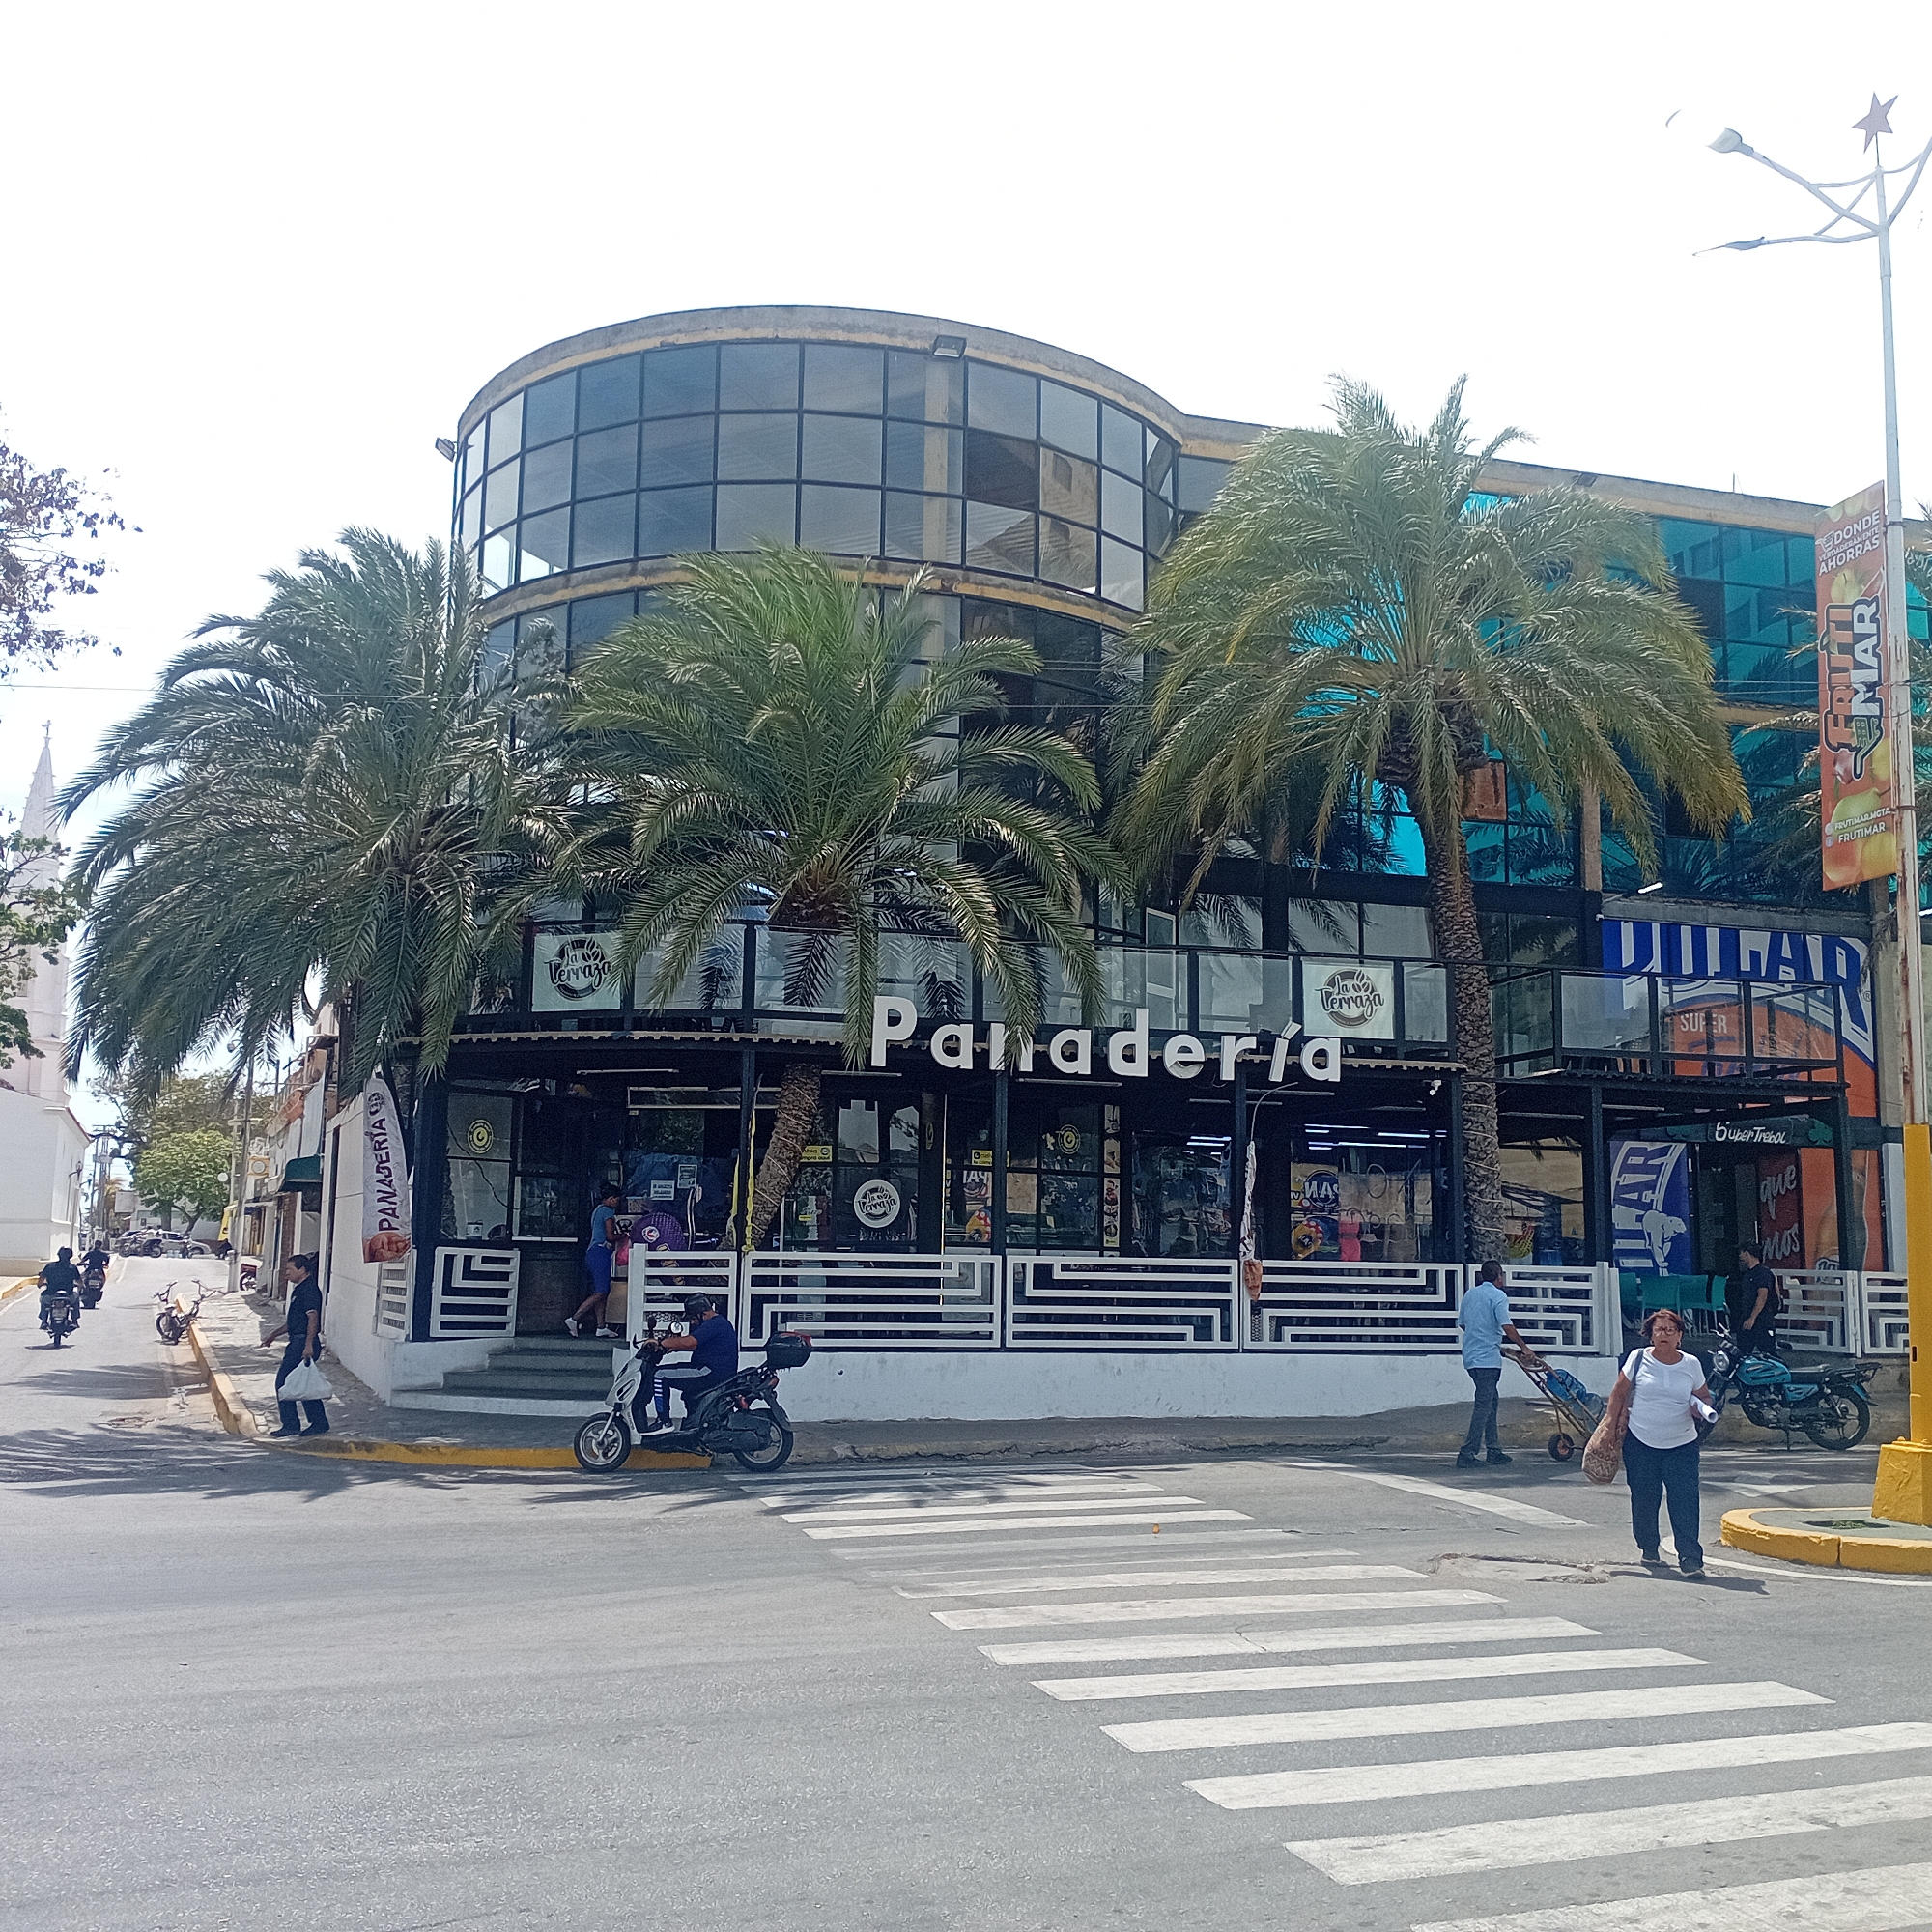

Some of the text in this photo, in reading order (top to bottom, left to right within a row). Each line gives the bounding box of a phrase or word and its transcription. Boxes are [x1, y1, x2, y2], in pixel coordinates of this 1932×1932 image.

[1833, 509, 1880, 545] DONDE
[1818, 526, 1880, 562] VERDADERAMENTE
[1818, 534, 1880, 577] AHORRAS
[1838, 821, 1886, 844] FRUTIMAR
[562, 946, 579, 967] La
[544, 957, 611, 988] Terraza
[1335, 975, 1350, 996] La
[1314, 987, 1385, 1018] Terraza
[871, 996, 1341, 1082] Panadería
